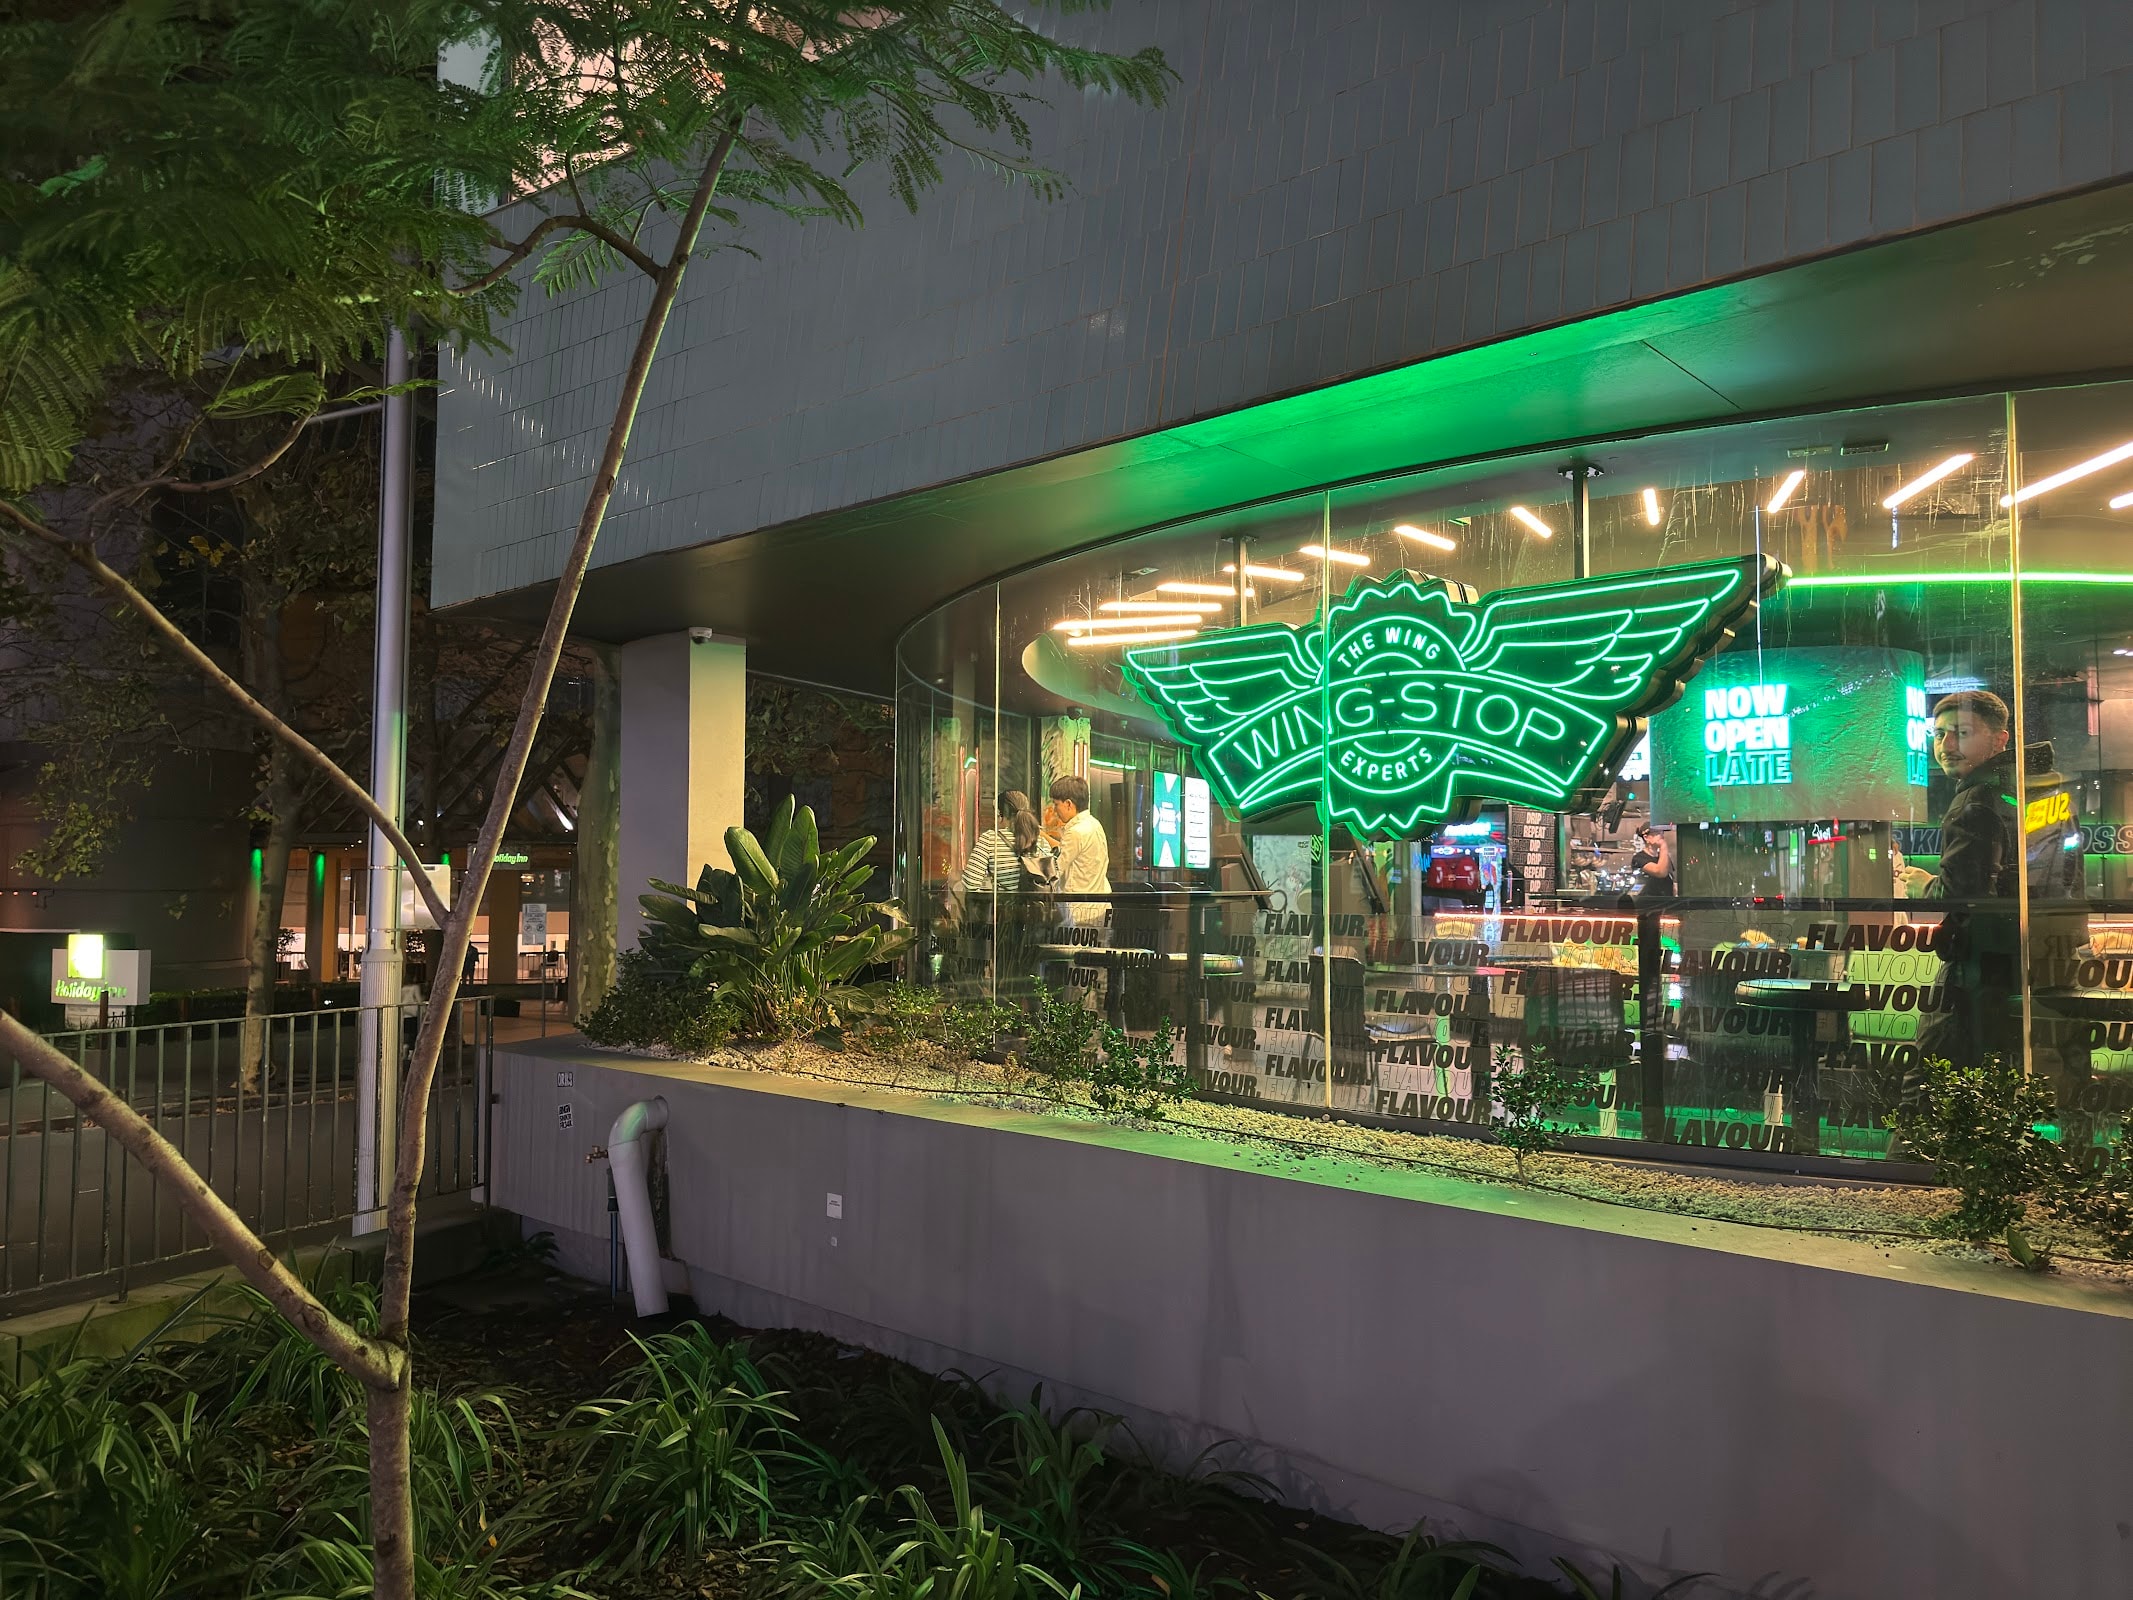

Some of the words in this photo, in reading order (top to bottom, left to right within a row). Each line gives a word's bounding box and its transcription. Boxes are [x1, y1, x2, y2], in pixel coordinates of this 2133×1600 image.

[1337, 632, 1376, 668] THE
[1386, 626, 1441, 660] WING
[1705, 684, 1787, 720] NOW
[1233, 681, 1566, 770] WING-STOP
[1704, 718, 1790, 753] OPEN
[1340, 747, 1432, 781] EXPERTS
[1705, 750, 1792, 787] LATE
[1523, 825, 1546, 838] REPEAT
[494, 852, 516, 865] oliday
[1524, 866, 1547, 879] REPEAT
[1806, 923, 1937, 952] FLAVOU
[55, 979, 102, 1002] Holiday
[1664, 1117, 1793, 1153] LAVOUR
